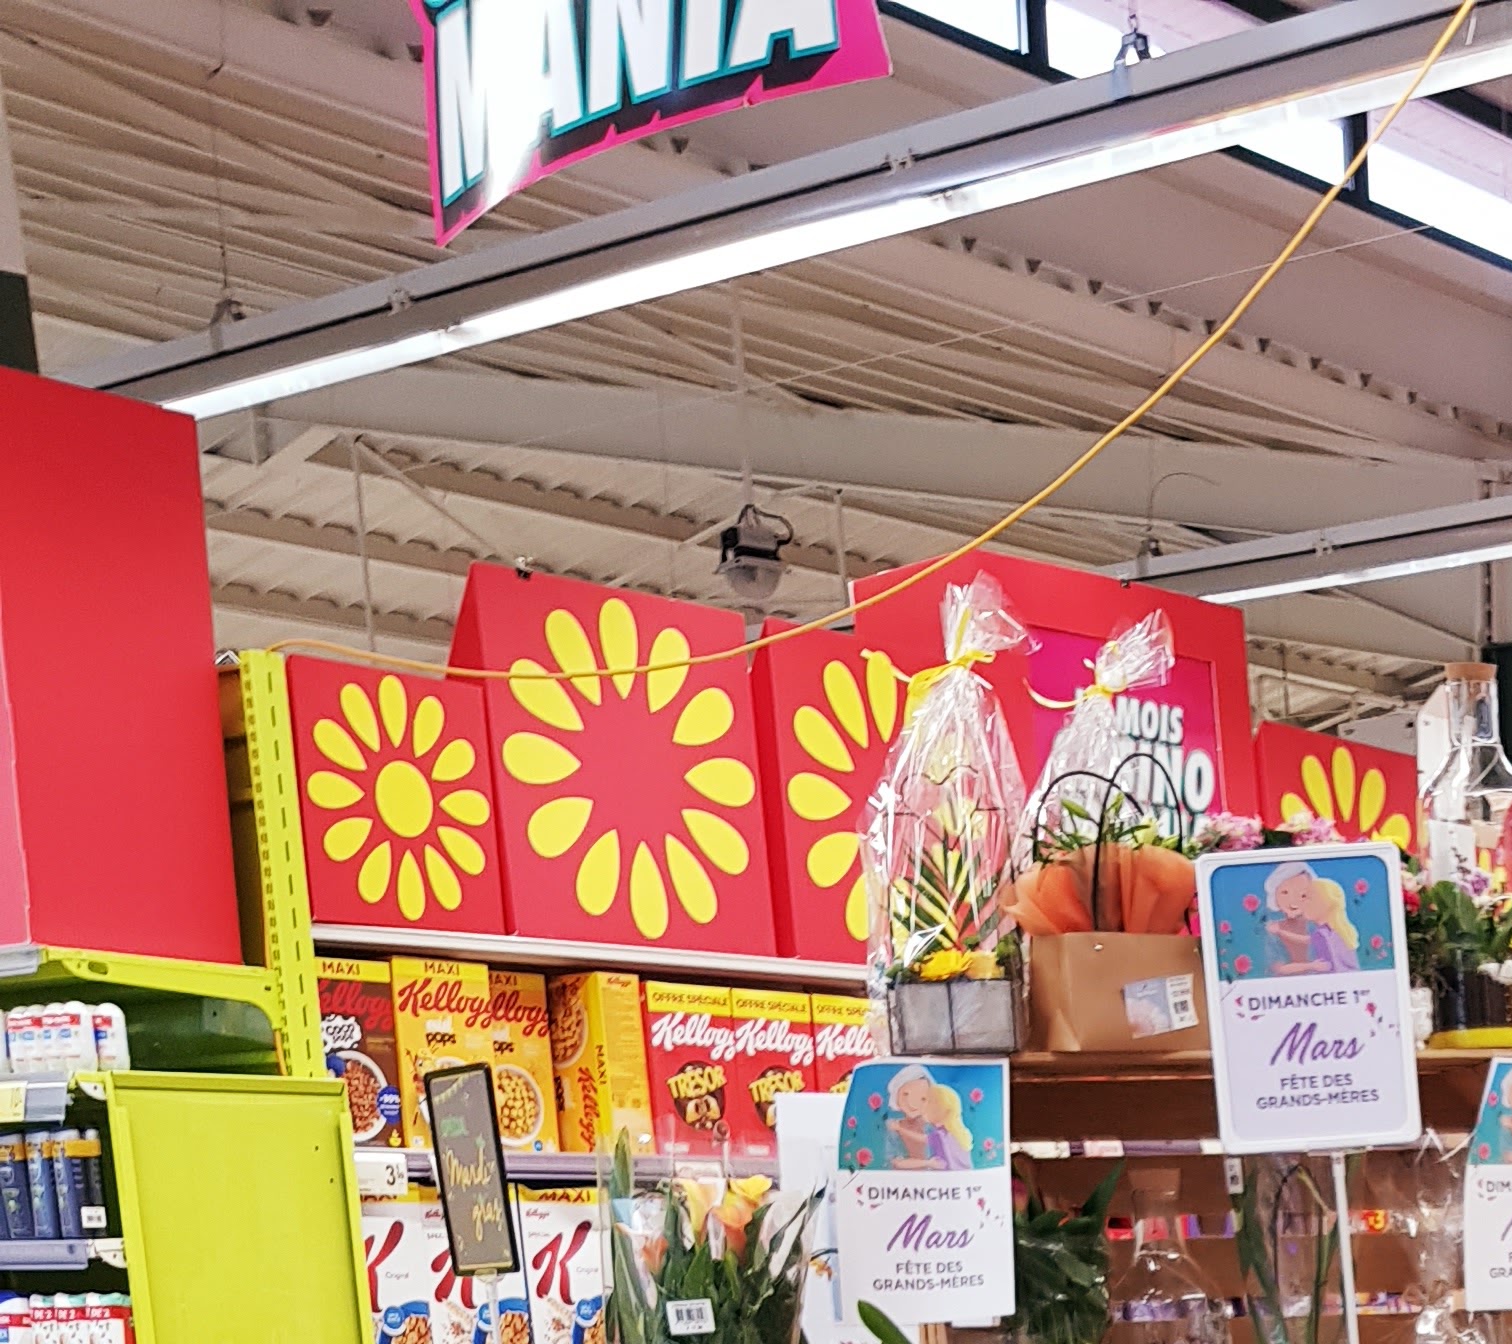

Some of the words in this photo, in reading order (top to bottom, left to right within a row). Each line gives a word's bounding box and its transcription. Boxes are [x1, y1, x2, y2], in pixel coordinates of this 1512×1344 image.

[1115, 696, 1184, 746] MOIS
[322, 961, 361, 976] MAXI
[424, 962, 460, 976] MAXI
[1248, 990, 1348, 1011] DIMANCHE
[1268, 1022, 1365, 1066] Mars
[1279, 1073, 1318, 1090] FÊTE
[1322, 1072, 1353, 1088] DES
[1255, 1088, 1380, 1110] GRANDS-MÈRES
[537, 1189, 592, 1203] MAXI
[867, 1186, 961, 1201] DIMANCHE
[965, 1185, 983, 1199] 1er
[886, 1212, 975, 1253] Mars
[532, 1219, 593, 1306] K
[895, 1259, 933, 1275] FÊTE
[936, 1260, 963, 1274] DES
[872, 1274, 985, 1291] GRANDS-MÈRES
